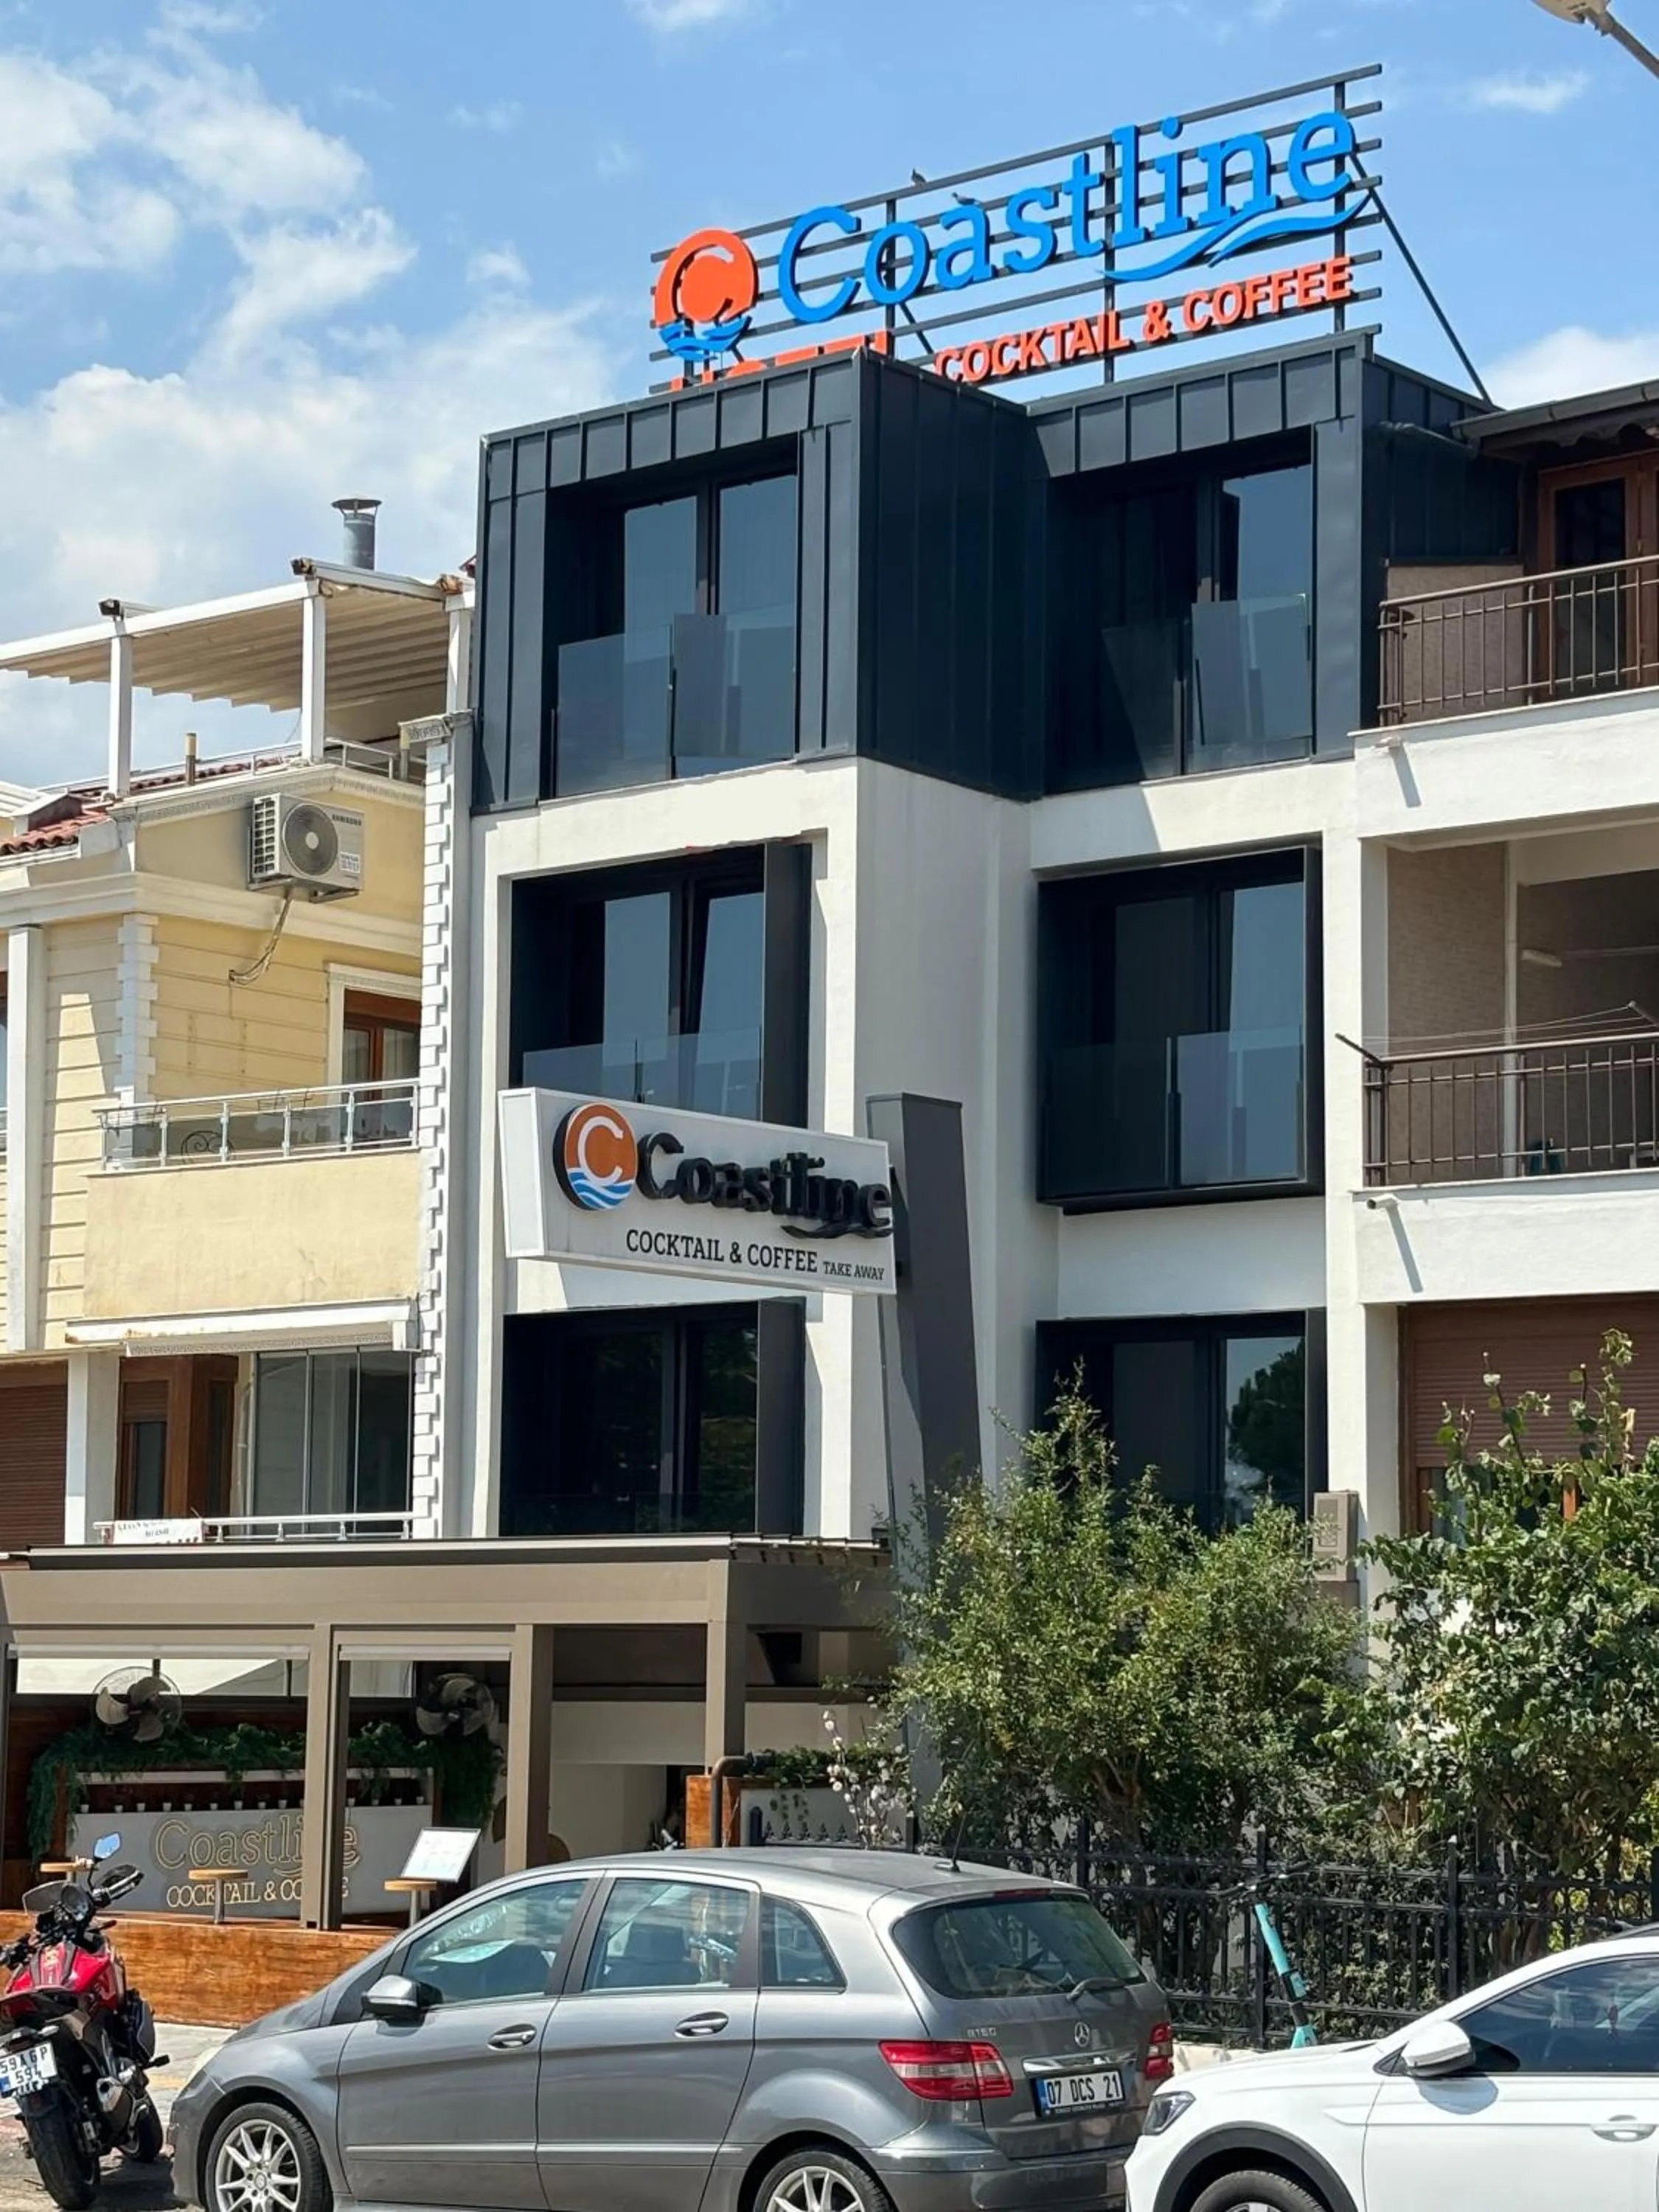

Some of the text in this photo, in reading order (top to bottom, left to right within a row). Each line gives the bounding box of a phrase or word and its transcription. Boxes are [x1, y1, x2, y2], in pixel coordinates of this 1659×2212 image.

[776, 108, 1357, 327] Coastline
[933, 310, 1131, 383] COCKTAIL
[1142, 299, 1173, 343] &
[1183, 256, 1353, 333] COFFEE
[626, 1228, 886, 1281] COCKTAIL & COFFEE TAKE AWAY
[156, 1815, 359, 1870] Coastlie
[263, 1881, 278, 1902] &
[1046, 2080, 1062, 2105] 07
[1103, 2073, 1121, 2098] 21
